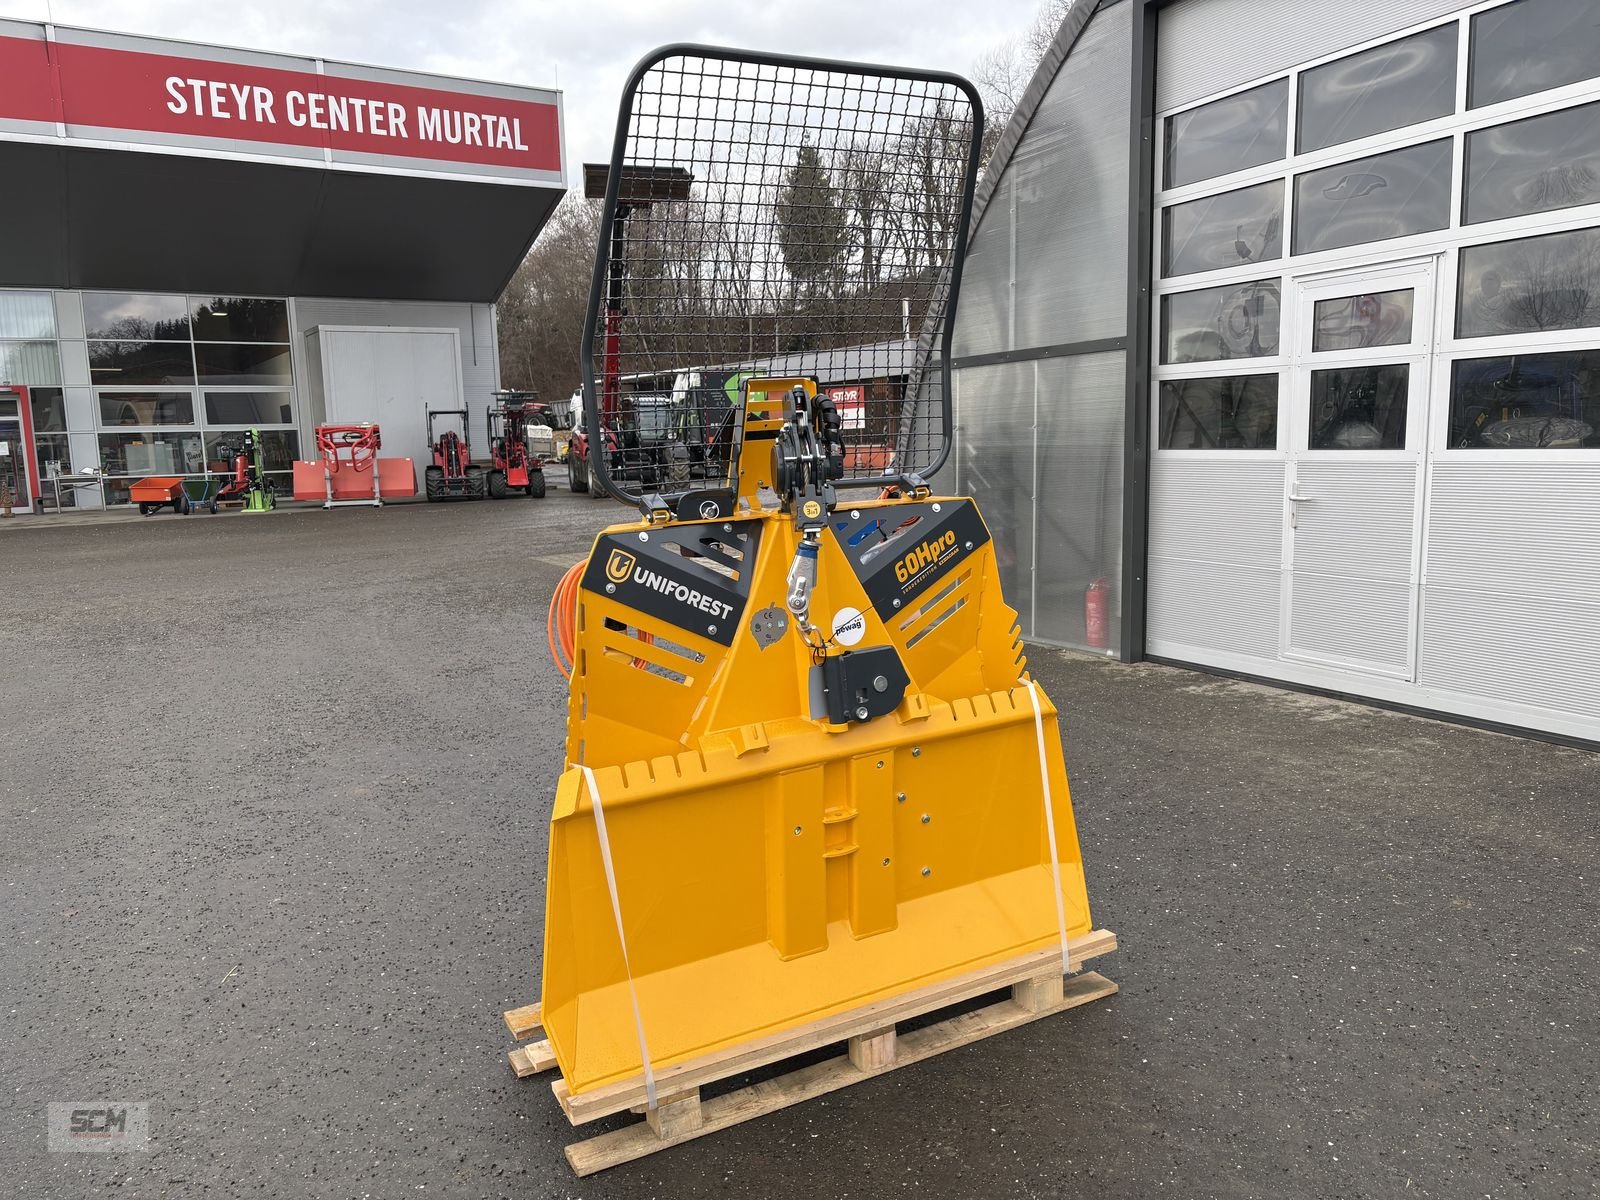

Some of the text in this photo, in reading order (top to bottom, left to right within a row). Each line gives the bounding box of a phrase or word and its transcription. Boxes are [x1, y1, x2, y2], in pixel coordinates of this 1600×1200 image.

[166, 76, 529, 151] STEYR CENTER MURTAL
[894, 530, 956, 583] 60Hpro
[633, 566, 733, 620] UNIFOREST
[835, 619, 862, 636] pewag
